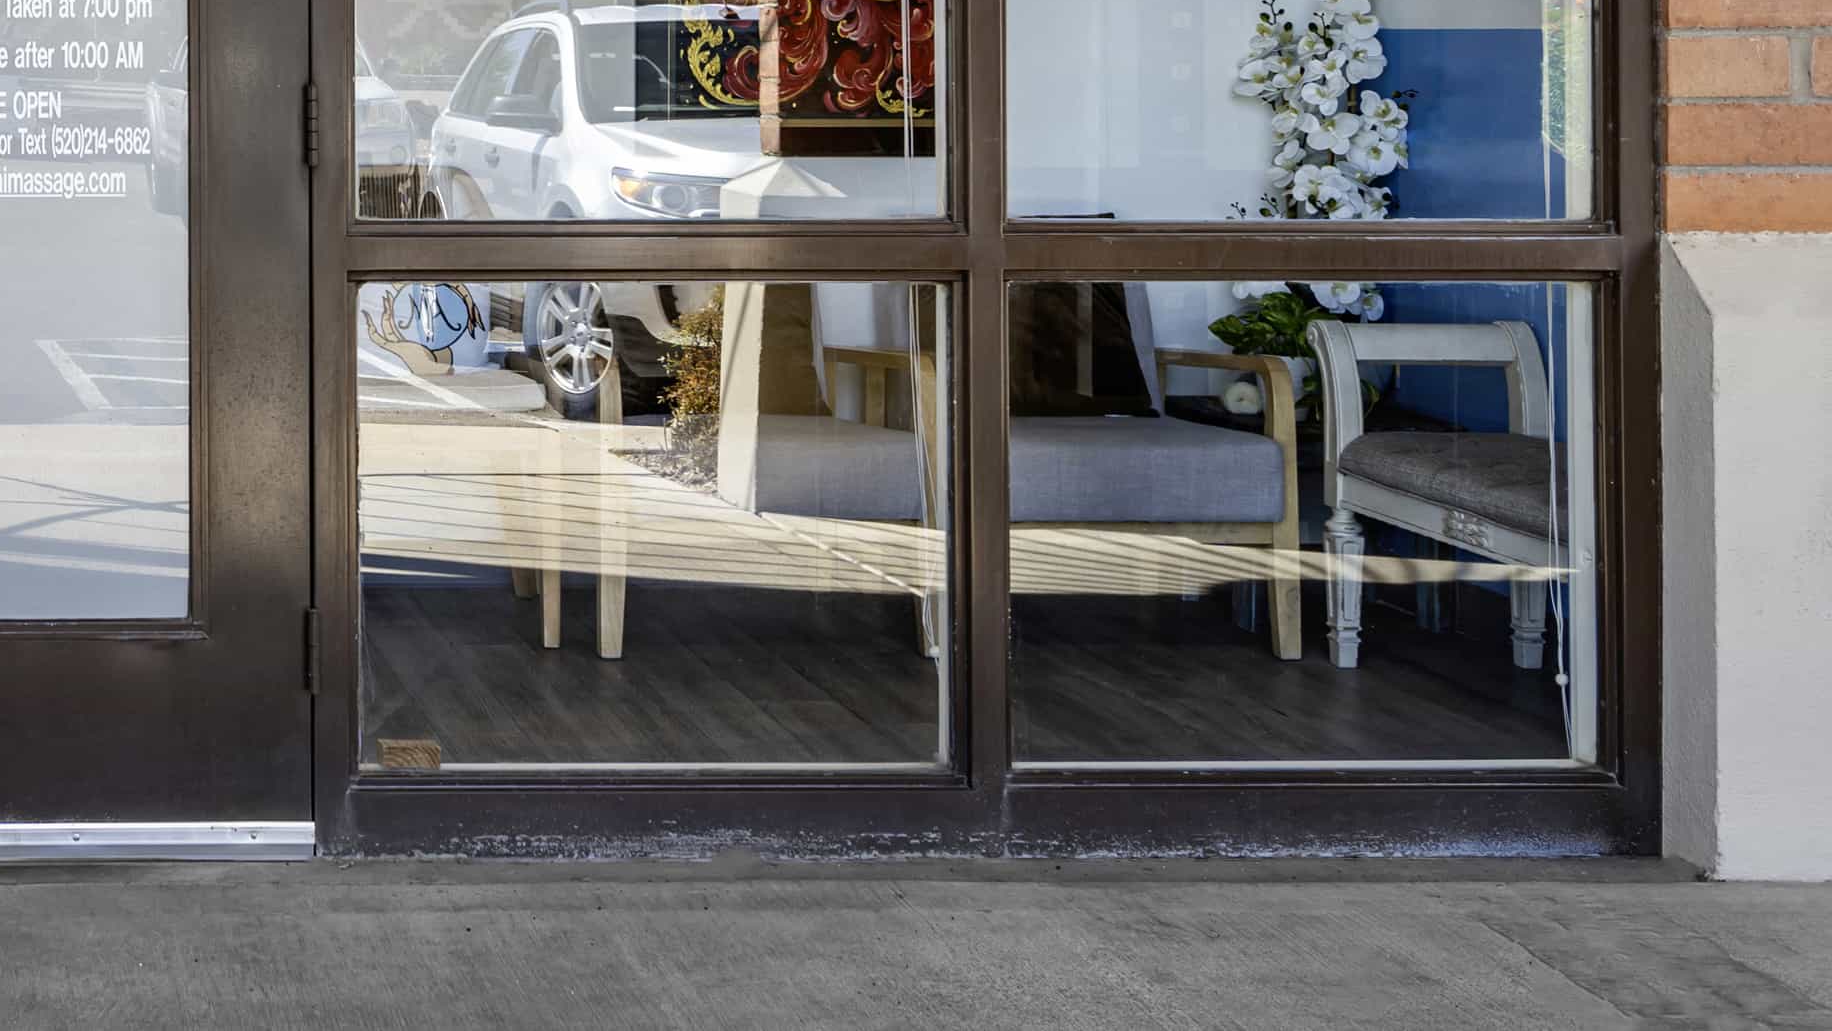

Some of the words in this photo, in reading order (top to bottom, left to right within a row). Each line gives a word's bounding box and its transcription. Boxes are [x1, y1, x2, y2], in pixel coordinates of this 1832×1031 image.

[14, 41, 55, 69] after
[61, 41, 108, 69] 10:00
[115, 41, 144, 69] AM
[13, 91, 62, 119] OPEN
[18, 127, 47, 156] Text
[51, 124, 151, 159] (520)214-6862
